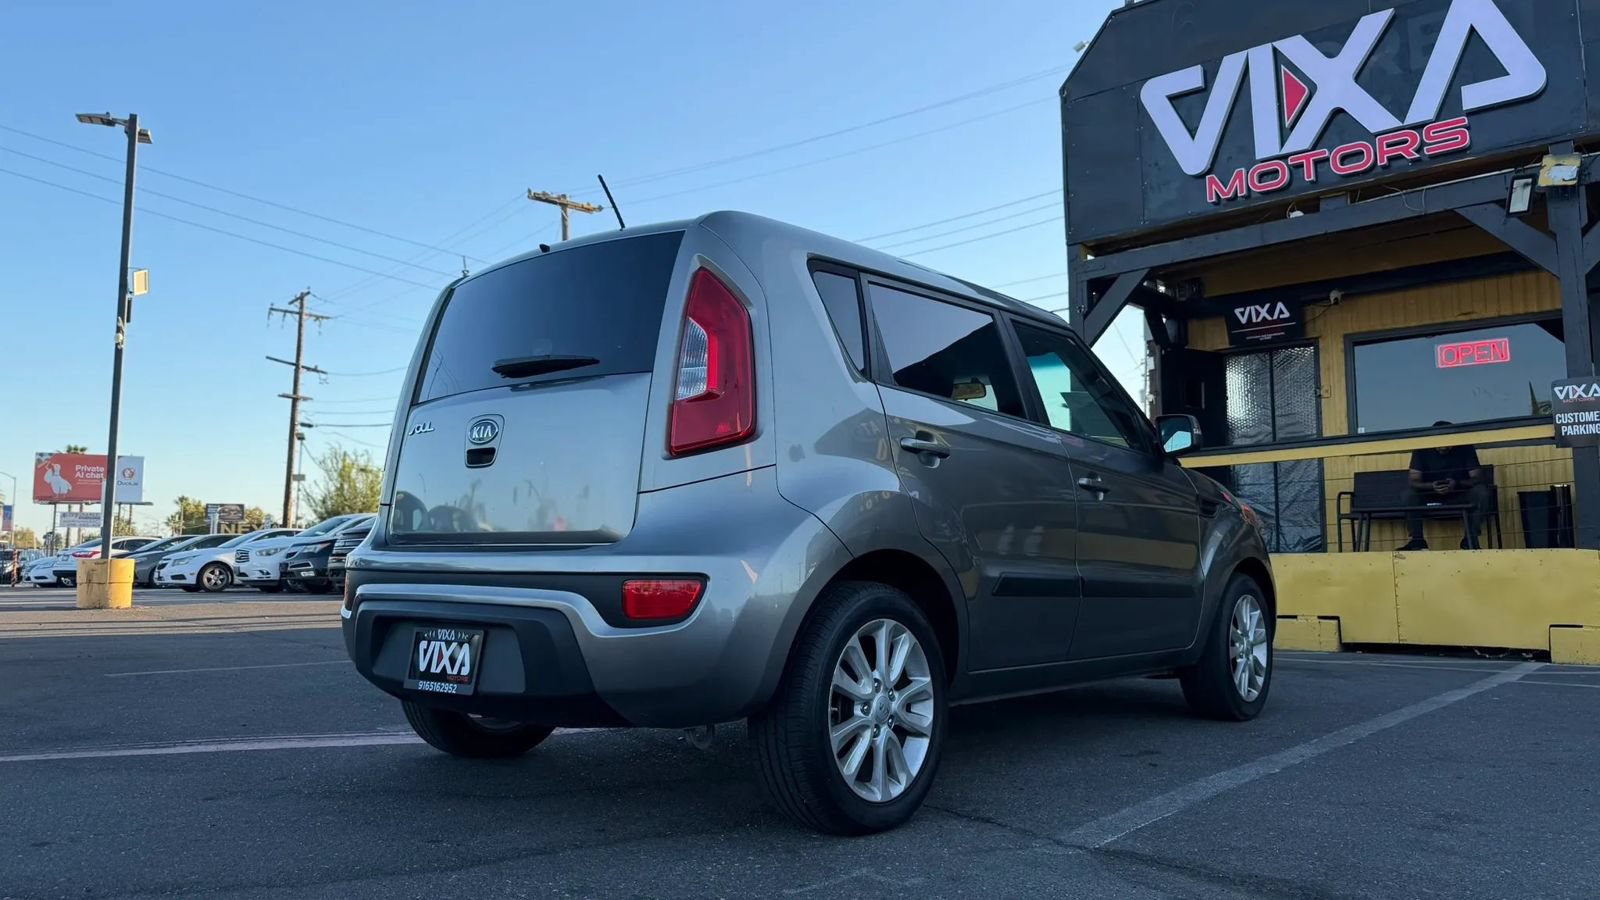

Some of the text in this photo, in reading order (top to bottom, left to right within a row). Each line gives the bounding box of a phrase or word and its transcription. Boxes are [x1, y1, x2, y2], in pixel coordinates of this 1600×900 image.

[1140, 0, 1547, 176] VIXA
[1205, 116, 1470, 203] MOTORS
[1233, 301, 1291, 324] VIXA
[1442, 340, 1506, 365] OPEN
[1553, 383, 1600, 400] VIXA
[472, 425, 492, 438] KIA
[1561, 423, 1600, 437] PARKING
[75, 464, 105, 472] Private
[438, 629, 455, 640] VIXA
[419, 640, 470, 675] VIXA
[418, 681, 457, 693] 9165162952
